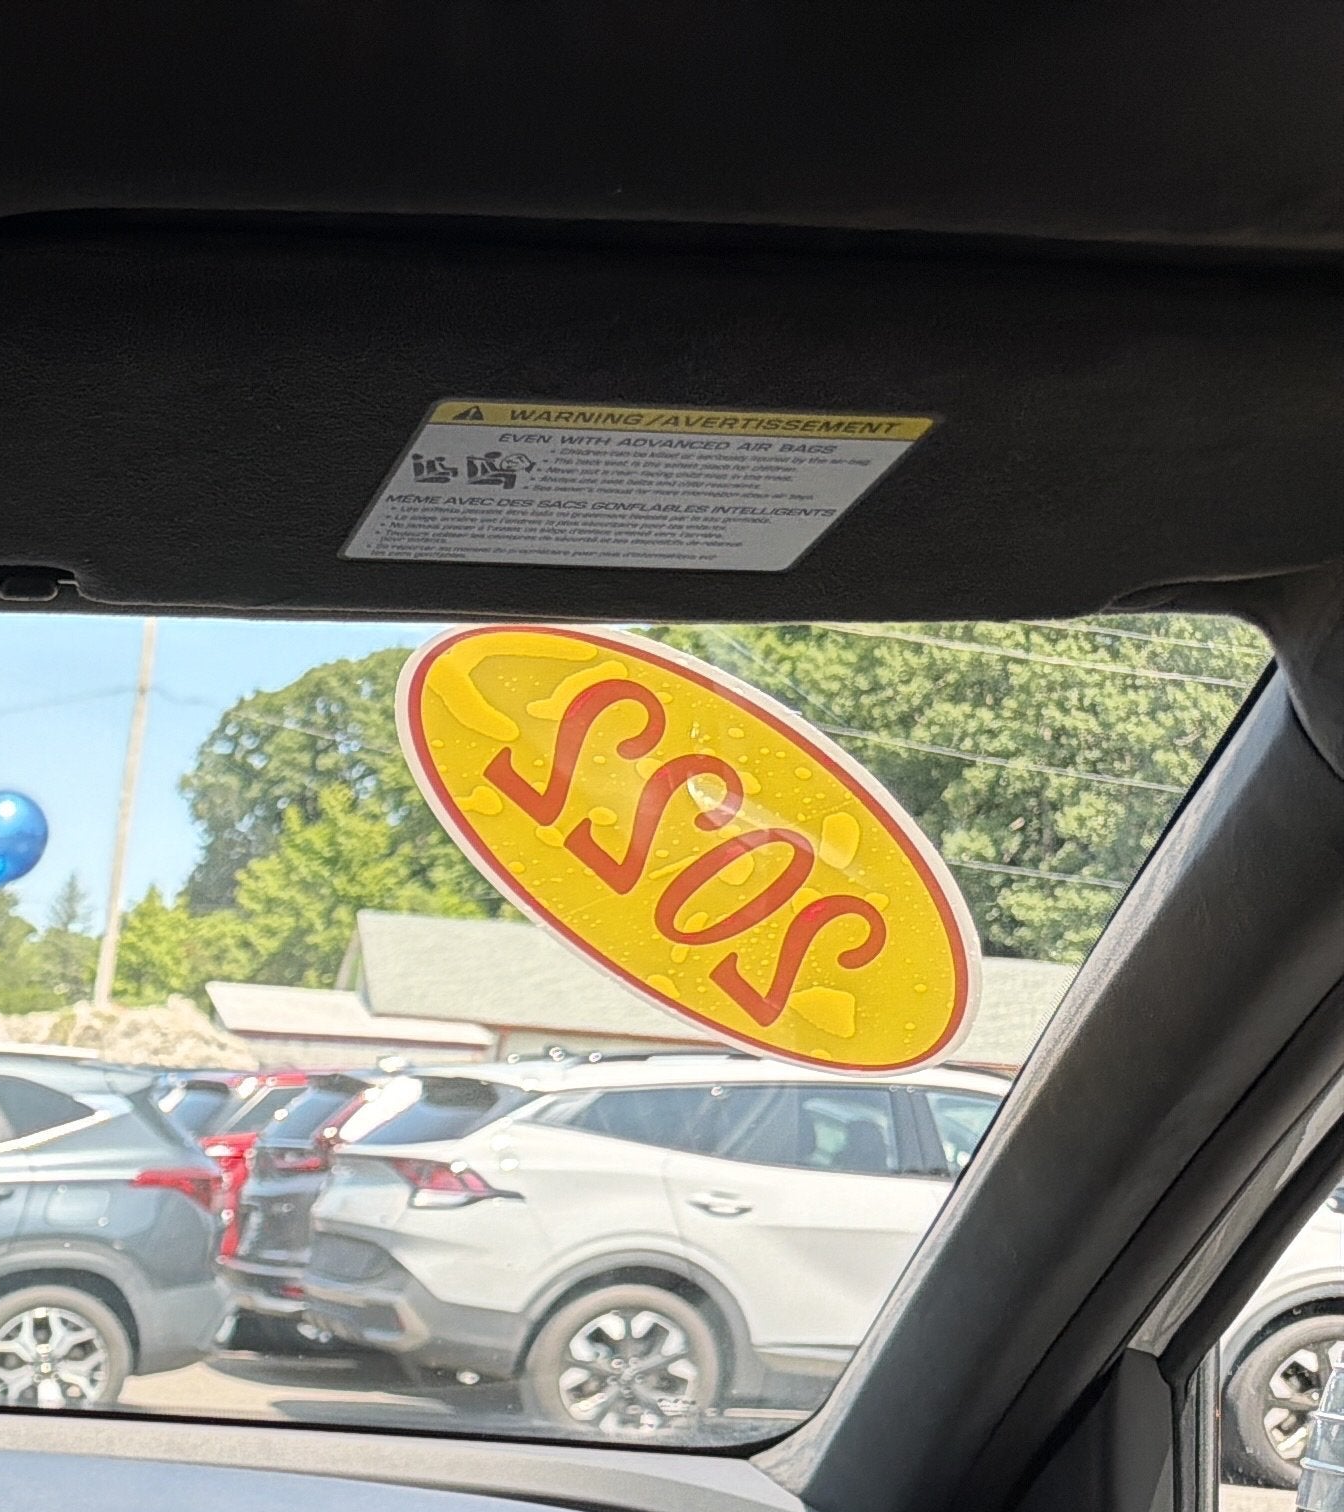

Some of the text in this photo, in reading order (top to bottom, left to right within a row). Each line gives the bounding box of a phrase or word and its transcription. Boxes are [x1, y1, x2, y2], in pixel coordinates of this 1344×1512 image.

[509, 409, 644, 428] WARNING
[497, 433, 838, 455] EVEN WITH ADVANCED AIR BAGS
